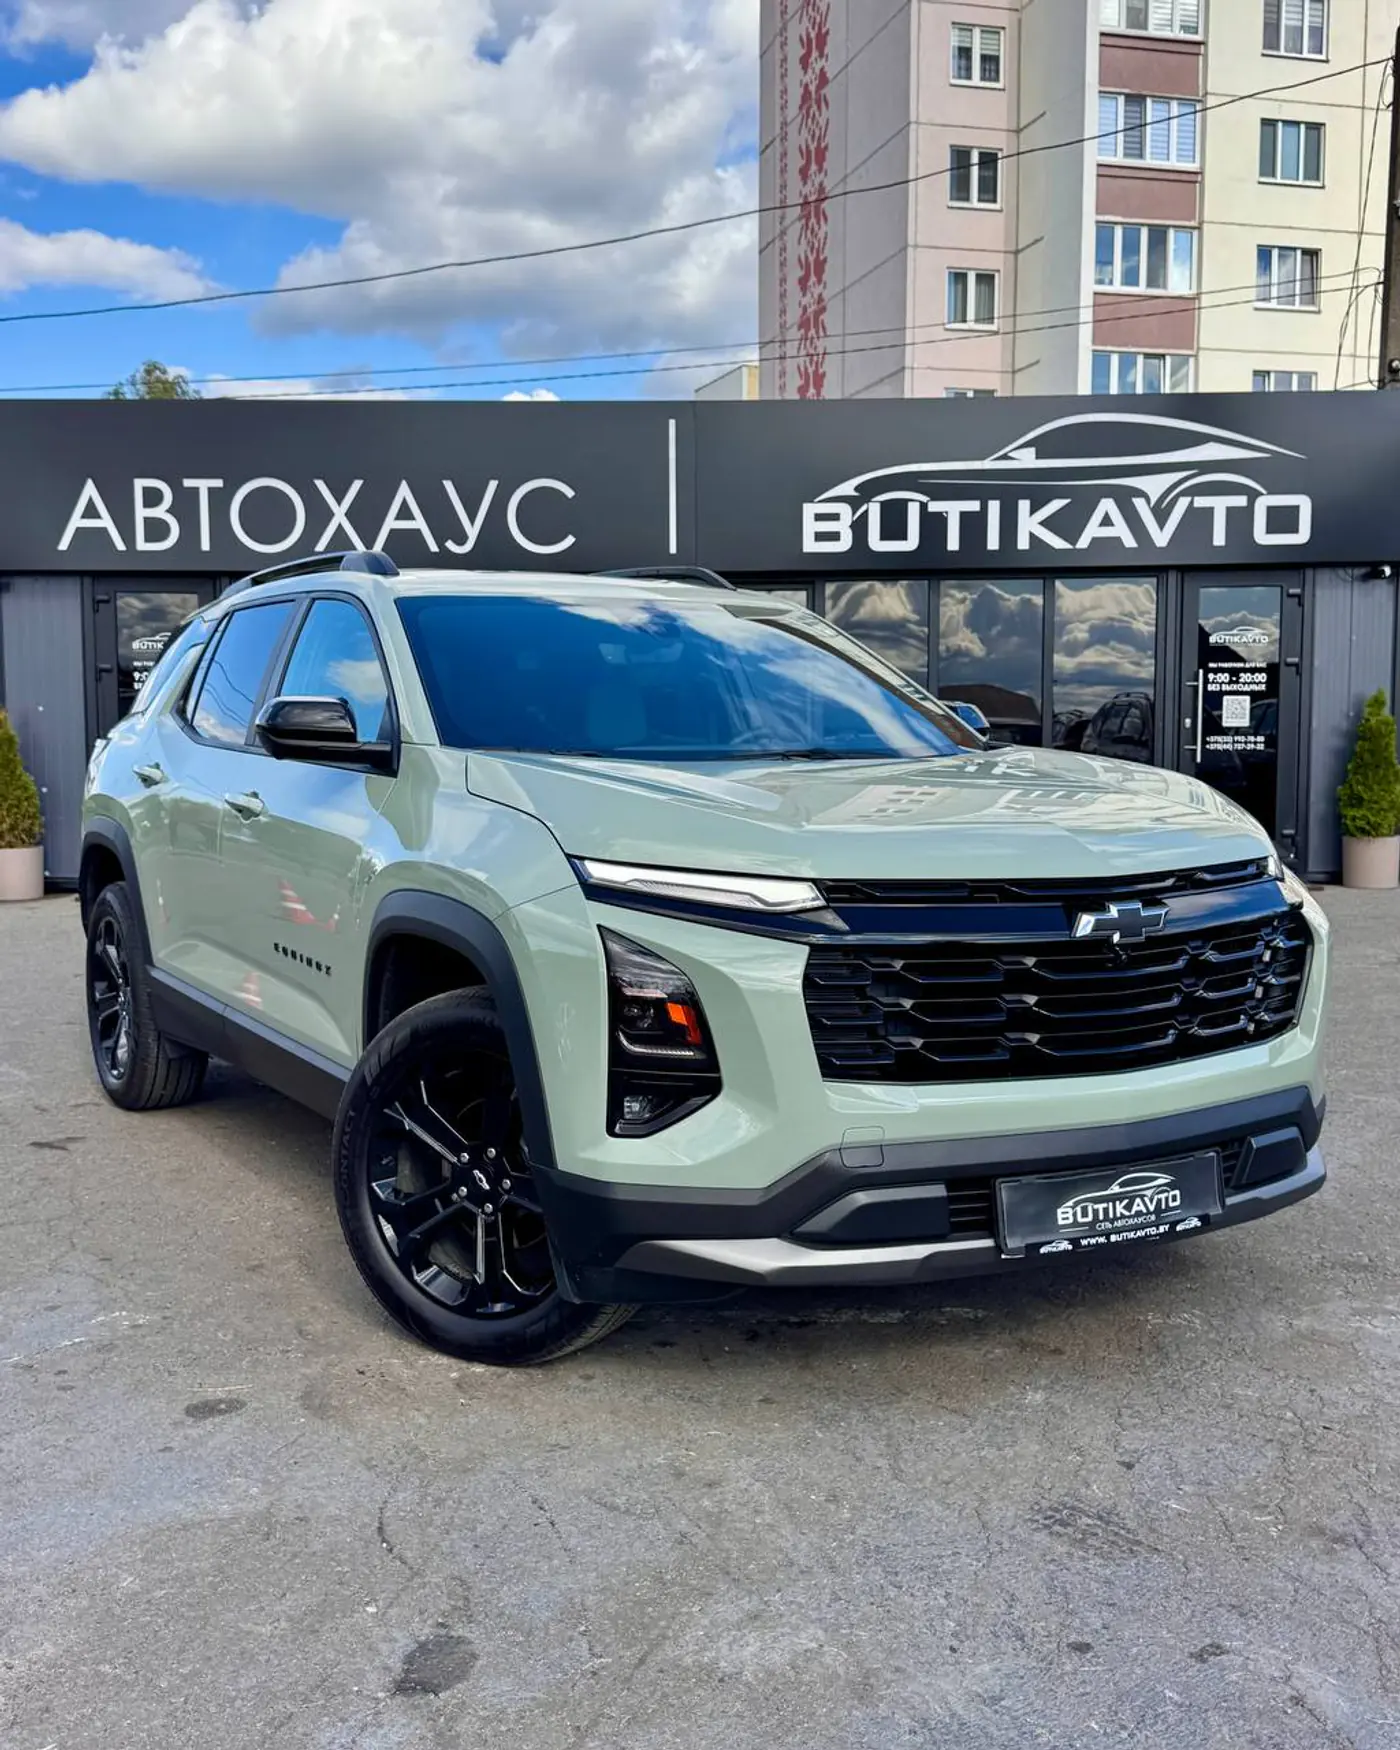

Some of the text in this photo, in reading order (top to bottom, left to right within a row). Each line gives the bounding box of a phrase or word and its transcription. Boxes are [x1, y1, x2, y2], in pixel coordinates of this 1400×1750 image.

[57, 477, 577, 554] АВТОХАУС
[802, 493, 1312, 553] BUTIKAVTO
[132, 641, 164, 650] BUTIK
[1209, 635, 1269, 643] BUTIKAVTO
[1208, 672, 1230, 682] 9:00
[1238, 672, 1267, 682] 20:00
[1057, 1190, 1181, 1225] BUTIKAVTO
[1080, 1224, 1170, 1246] WWW. BUTIKAVTO.BY
